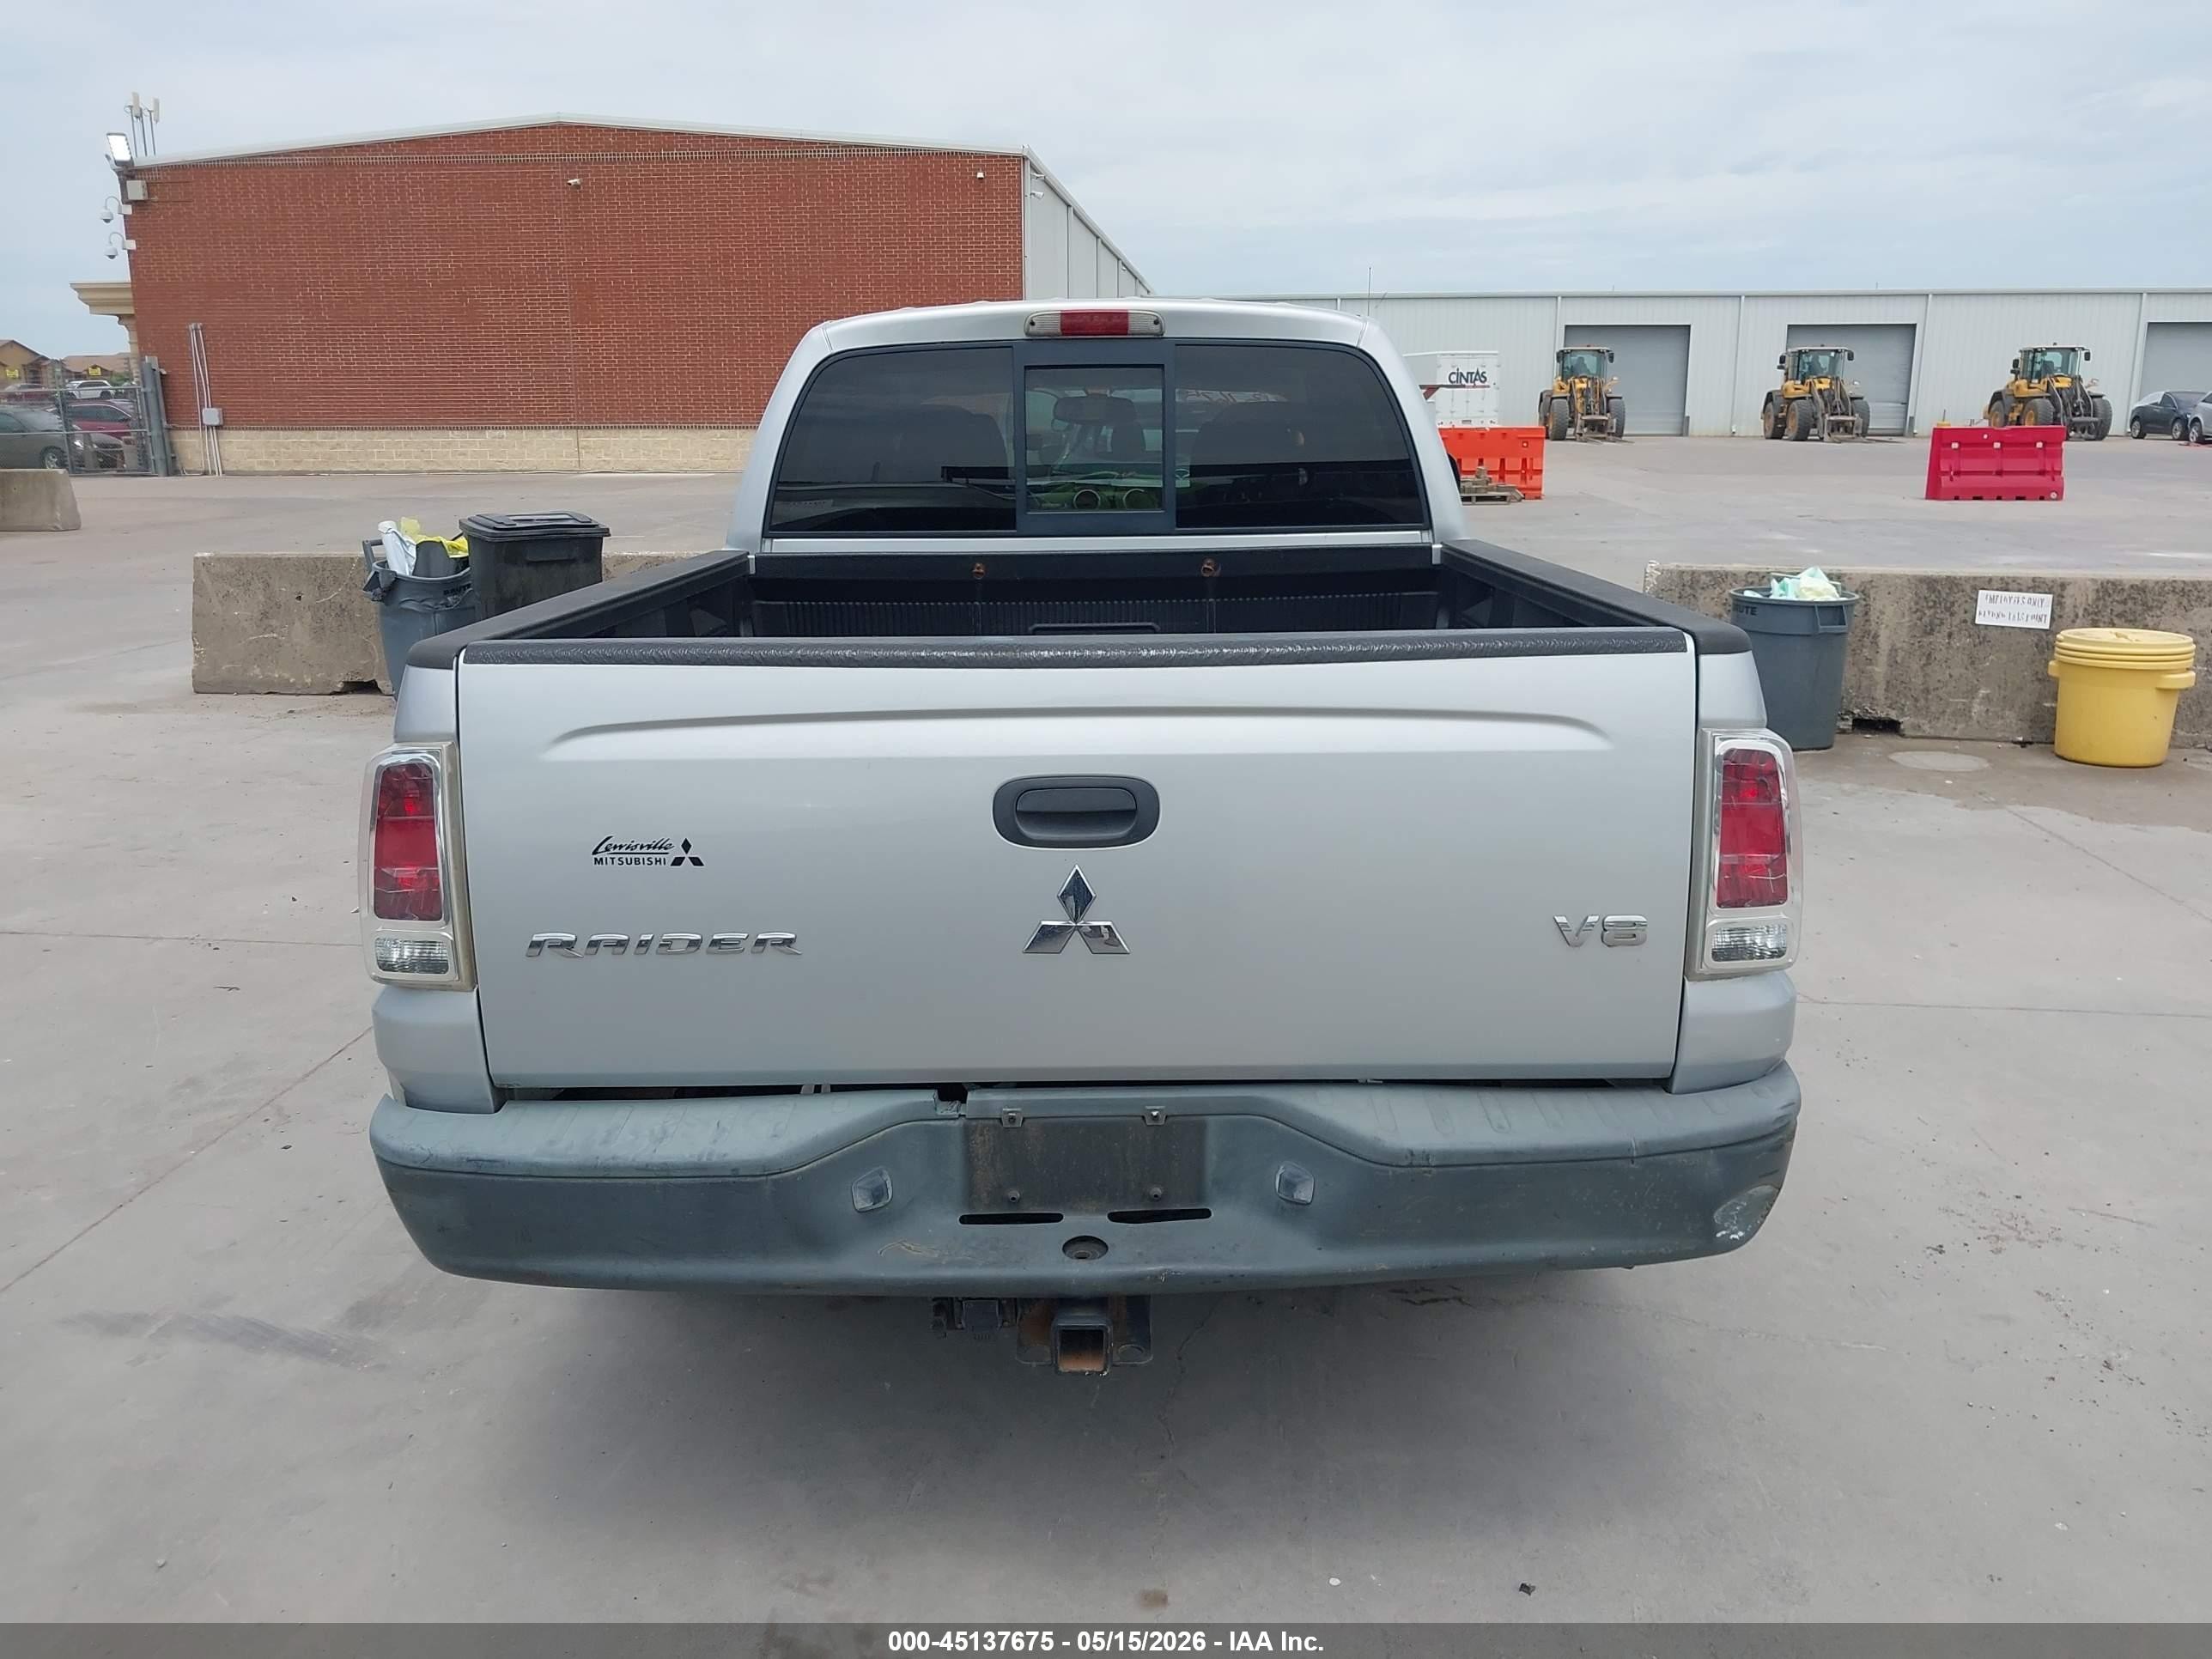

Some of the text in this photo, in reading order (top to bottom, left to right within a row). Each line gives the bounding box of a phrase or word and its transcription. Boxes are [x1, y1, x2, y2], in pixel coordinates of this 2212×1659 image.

[1449, 368, 1487, 384] CINTAS
[592, 836, 675, 855] Lewisville
[593, 857, 667, 866] MITSUBISHI
[1553, 915, 1648, 947] V8
[526, 932, 803, 958] RAIDER
